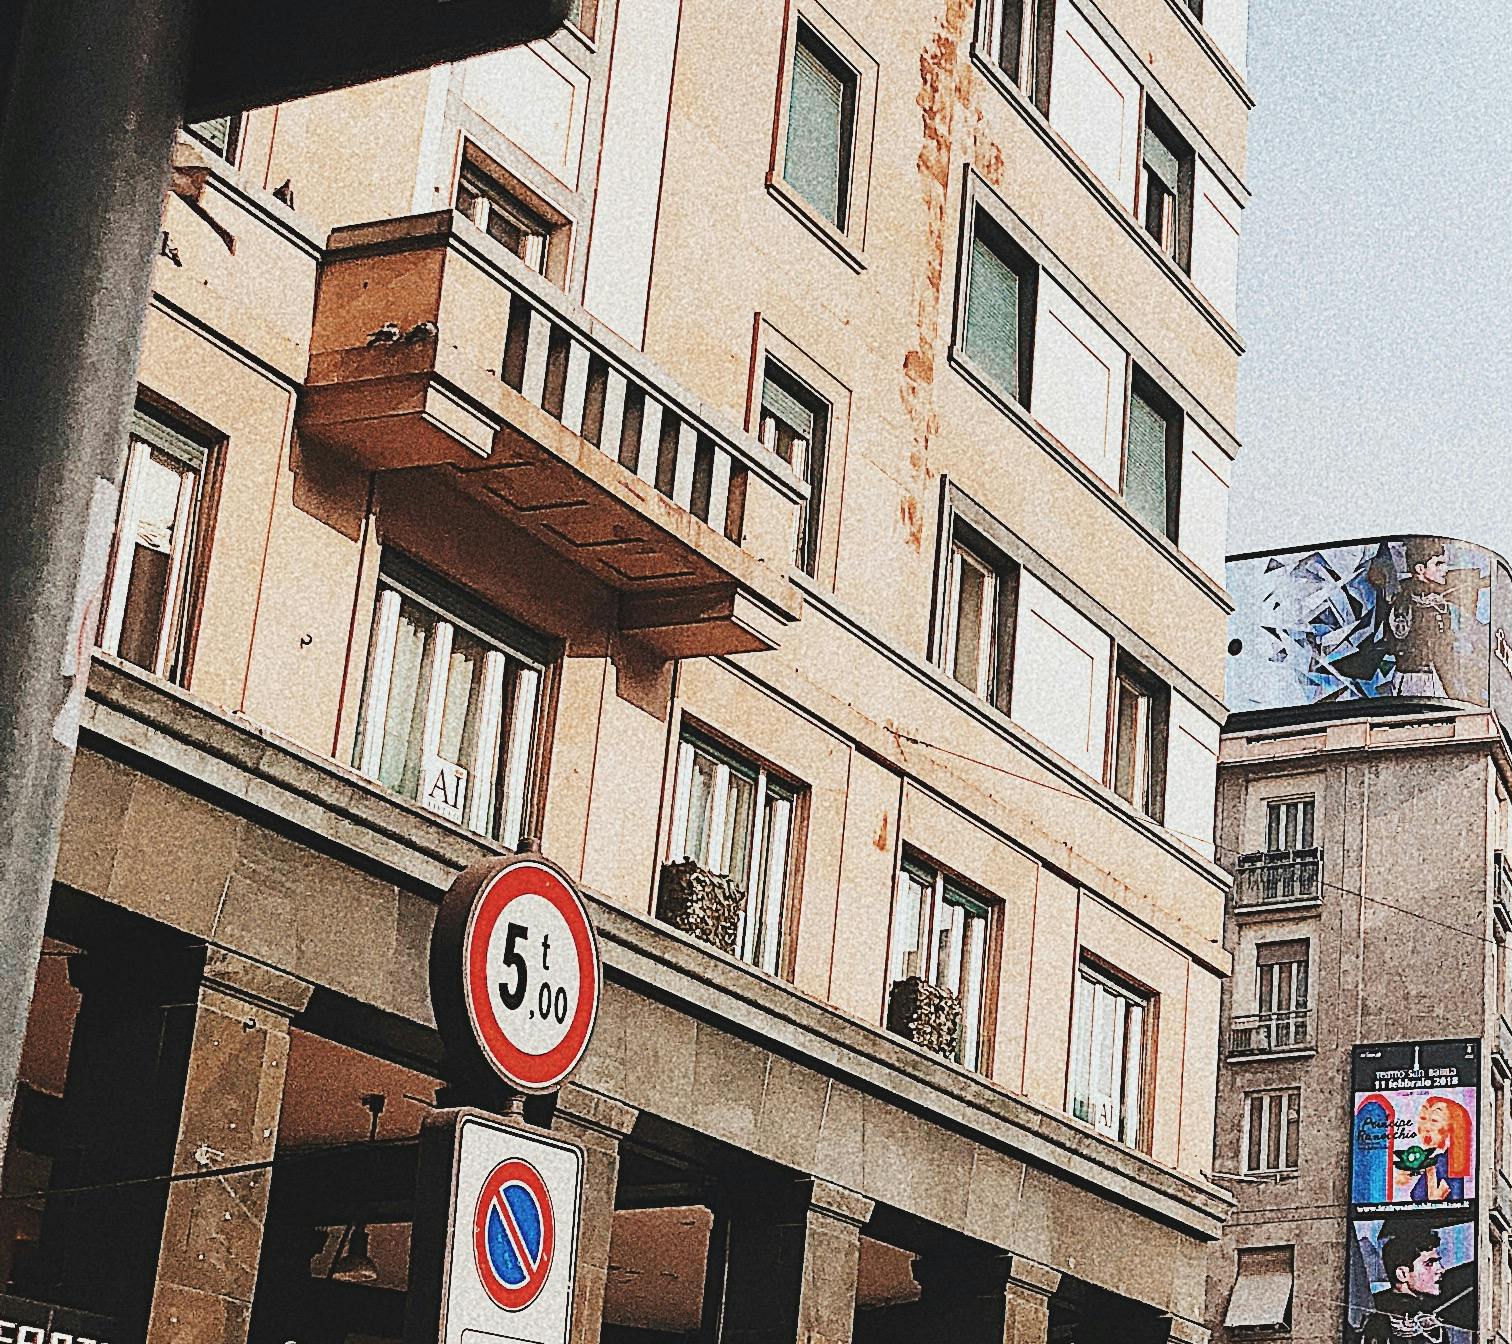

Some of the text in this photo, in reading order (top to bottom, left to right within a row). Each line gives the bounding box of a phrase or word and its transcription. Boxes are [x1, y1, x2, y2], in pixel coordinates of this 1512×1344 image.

[1375, 1075, 1459, 1090] 11 febbraio 2018
